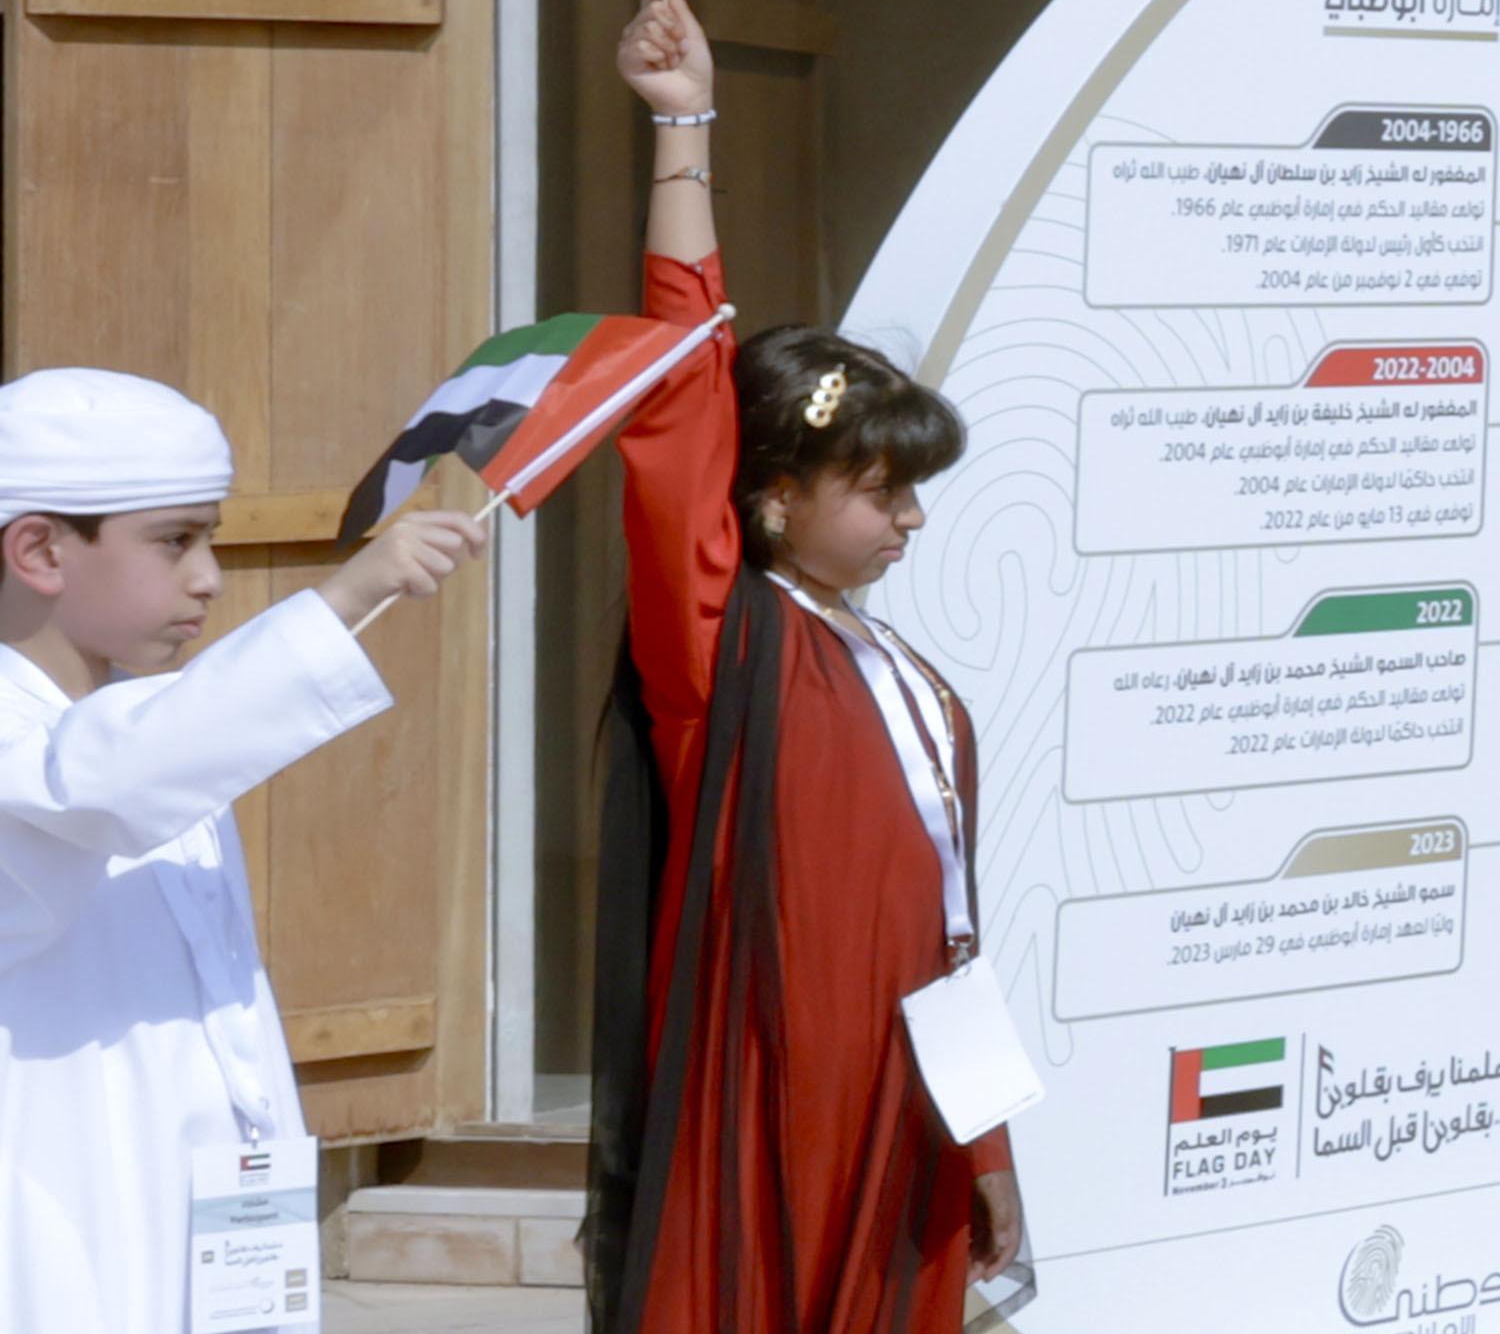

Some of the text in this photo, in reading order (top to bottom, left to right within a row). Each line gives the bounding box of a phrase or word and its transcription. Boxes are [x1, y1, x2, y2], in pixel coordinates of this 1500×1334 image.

[1381, 118, 1484, 143] 2004-1966
[1140, 162, 1164, 180] الله
[1267, 162, 1316, 185] سلطان
[1319, 163, 1335, 185] بن
[1339, 164, 1362, 186] زايد
[1365, 160, 1408, 186] الشيخ
[1413, 166, 1427, 182] له
[1429, 166, 1486, 186] المغفور
[1219, 199, 1244, 219] عام
[1248, 195, 1301, 221] أبوظبي
[1337, 201, 1362, 221] في
[1366, 199, 1405, 220] الحكم
[1262, 236, 1286, 256] عام
[1378, 234, 1412, 257] رئيس
[1304, 270, 1329, 291] عام
[1332, 272, 1353, 292] من
[1404, 269, 1413, 288] 2
[1416, 272, 1440, 292] في
[1373, 356, 1476, 380] 2022-2004
[1137, 408, 1162, 426] الله
[1266, 404, 1289, 427] زايد
[1292, 404, 1308, 426] بن
[1312, 402, 1353, 425] خليفة
[1356, 398, 1399, 423] الشيخ
[1403, 401, 1419, 418] له
[1421, 400, 1477, 421] المغفور
[1210, 443, 1234, 463] عام
[1238, 435, 1291, 463] أبوظبي
[1328, 441, 1353, 461] في
[1357, 437, 1396, 459] الحكم
[1283, 476, 1308, 497] عام
[1307, 510, 1331, 531] عام
[1334, 510, 1354, 530] من
[1389, 505, 1403, 524] 13
[1407, 506, 1431, 527] في
[1416, 599, 1462, 624] 2022
[1285, 661, 1325, 680] محمد
[1329, 652, 1373, 679] الشيخ
[1376, 652, 1423, 675] السمو
[1426, 650, 1466, 672] صاحب
[1113, 672, 1138, 691] الله
[1238, 663, 1261, 686] زايد
[1264, 662, 1281, 684] بن
[1228, 693, 1281, 722] أبوظبي
[1317, 696, 1342, 716] في
[1345, 690, 1385, 713] الحكم
[1198, 704, 1223, 726] عام
[1272, 733, 1296, 755] عام
[1409, 830, 1455, 856] 2023
[1322, 893, 1339, 915] بن
[1342, 889, 1369, 910] خالد
[1372, 882, 1416, 910] الشيخ
[1419, 884, 1455, 903] سمو
[1231, 901, 1254, 926] زايد
[1258, 901, 1274, 923] بن
[1278, 898, 1319, 917] محمد
[1255, 934, 1275, 955] 29
[1279, 932, 1304, 956] في
[1308, 920, 1359, 952] أبوظبي
[1397, 1060, 1445, 1097] يرف
[1173, 1126, 1277, 1157] يوم العلم
[1374, 1113, 1417, 1162] قبل
[1173, 1147, 1276, 1180] FLAG DAY
